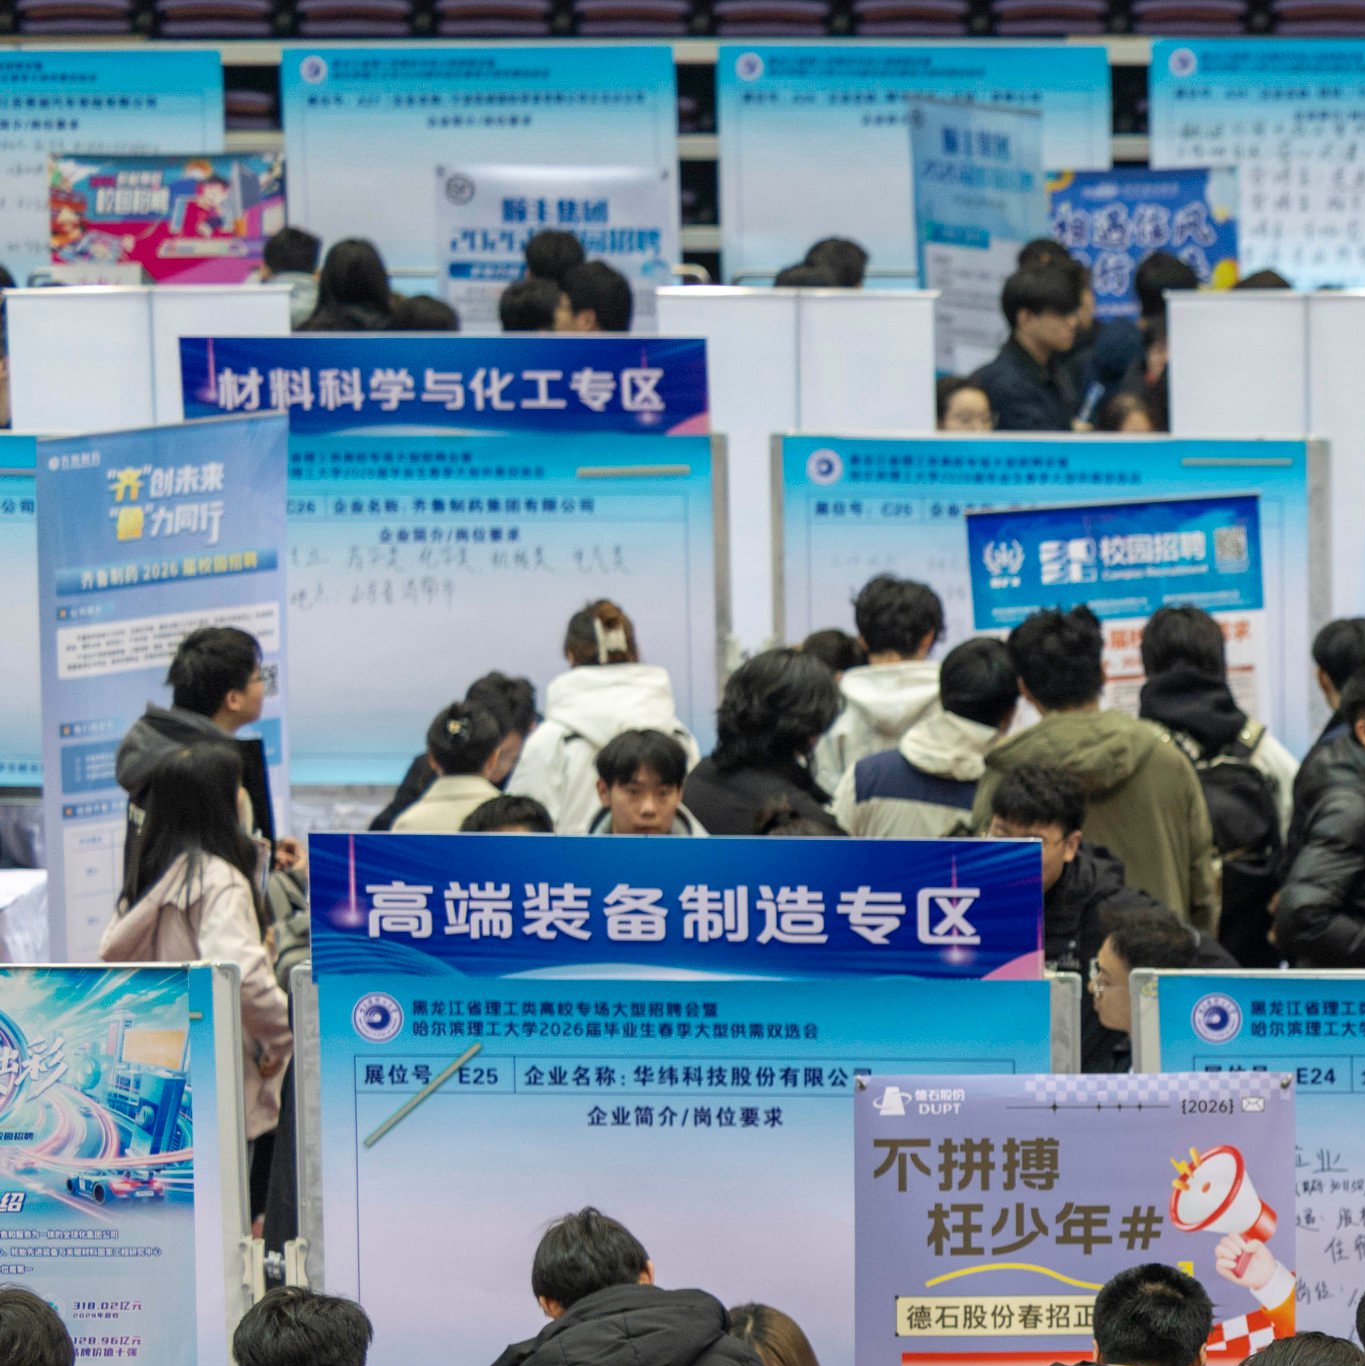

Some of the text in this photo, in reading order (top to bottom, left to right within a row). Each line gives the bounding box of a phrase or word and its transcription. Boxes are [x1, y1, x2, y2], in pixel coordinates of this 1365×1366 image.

[217, 367, 665, 414] 材料科学与化工专区
[1099, 531, 1207, 566] 校园招聘
[365, 880, 982, 946] 高端装备制造专区
[411, 999, 720, 1021] 黑龙江省理工类高校专场大型招聘会暨
[411, 1020, 821, 1042] 哈尔滨理工大学2026届毕业生春季大型供需双选会
[457, 1066, 499, 1087] E25
[1296, 1067, 1337, 1086] E24
[586, 1105, 785, 1128] 企业简介/岗位要求
[917, 1101, 961, 1116] DUPT
[872, 1136, 1061, 1193] 不拼搏
[926, 1202, 1165, 1257] 枉少年#
